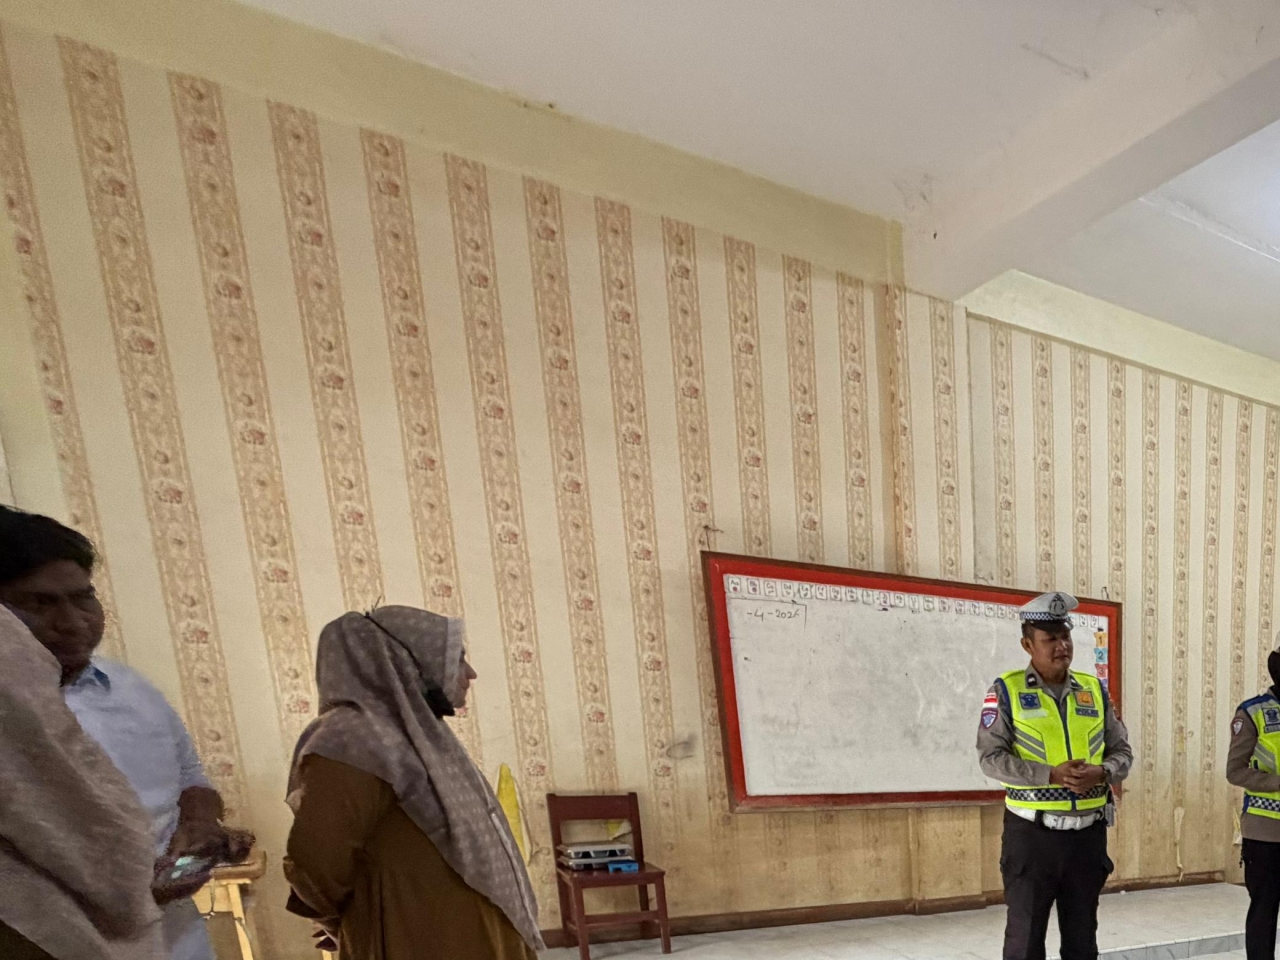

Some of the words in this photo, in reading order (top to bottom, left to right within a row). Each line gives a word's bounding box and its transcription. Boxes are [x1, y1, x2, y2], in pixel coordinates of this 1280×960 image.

[1098, 635, 1103, 645] 1
[1097, 651, 1104, 660] 2
[1098, 666, 1104, 675] 3
